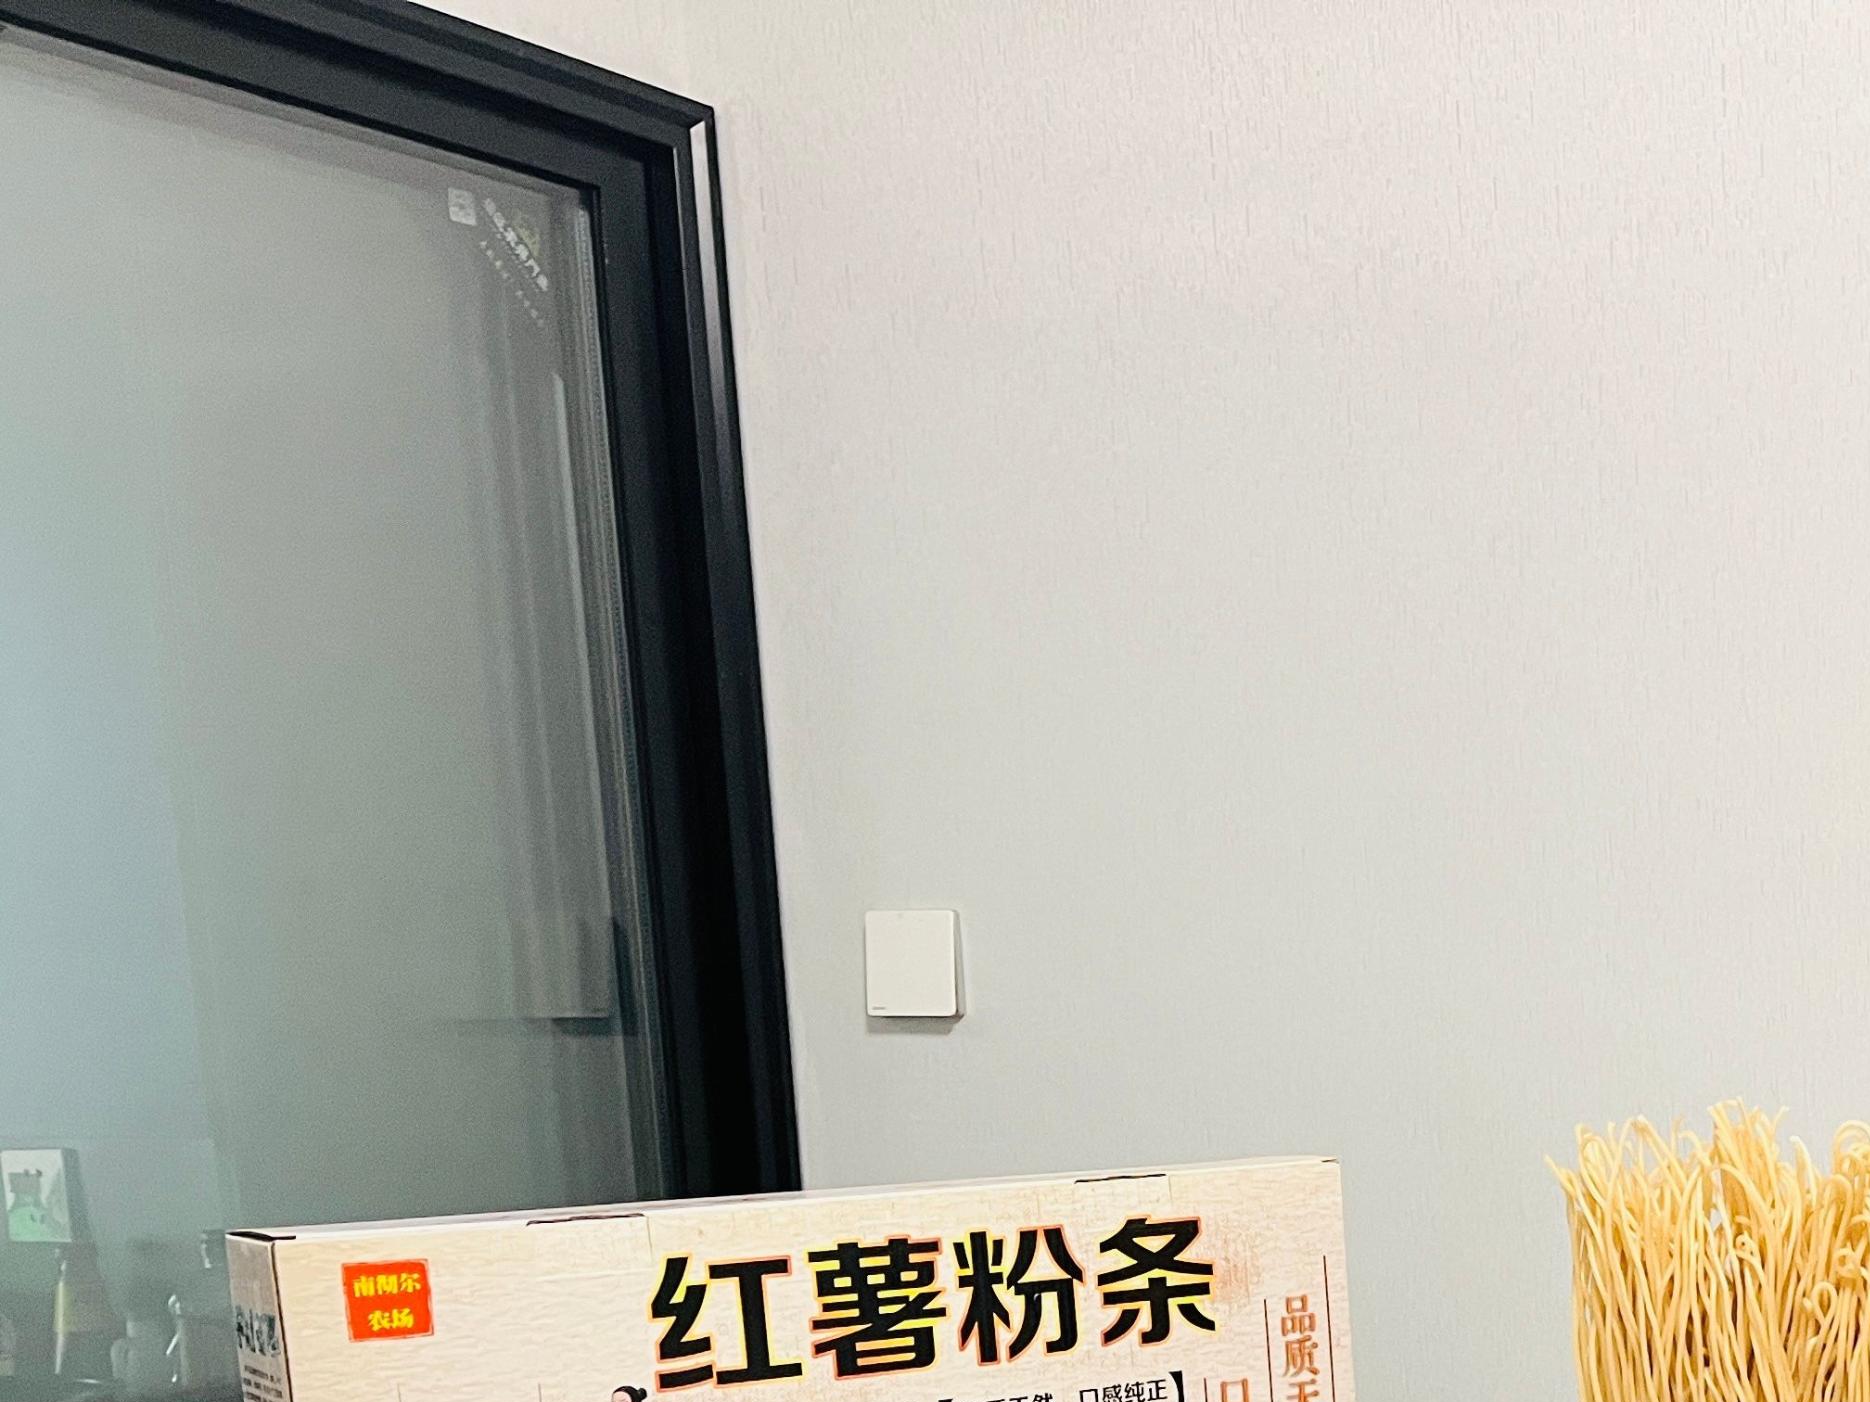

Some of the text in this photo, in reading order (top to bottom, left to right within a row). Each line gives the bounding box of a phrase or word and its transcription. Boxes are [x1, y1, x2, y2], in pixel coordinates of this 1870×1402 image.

[353, 1272, 421, 1297] 南彻尔
[650, 1215, 1217, 1392] 红薯粉条
[367, 1307, 414, 1331] 农场
